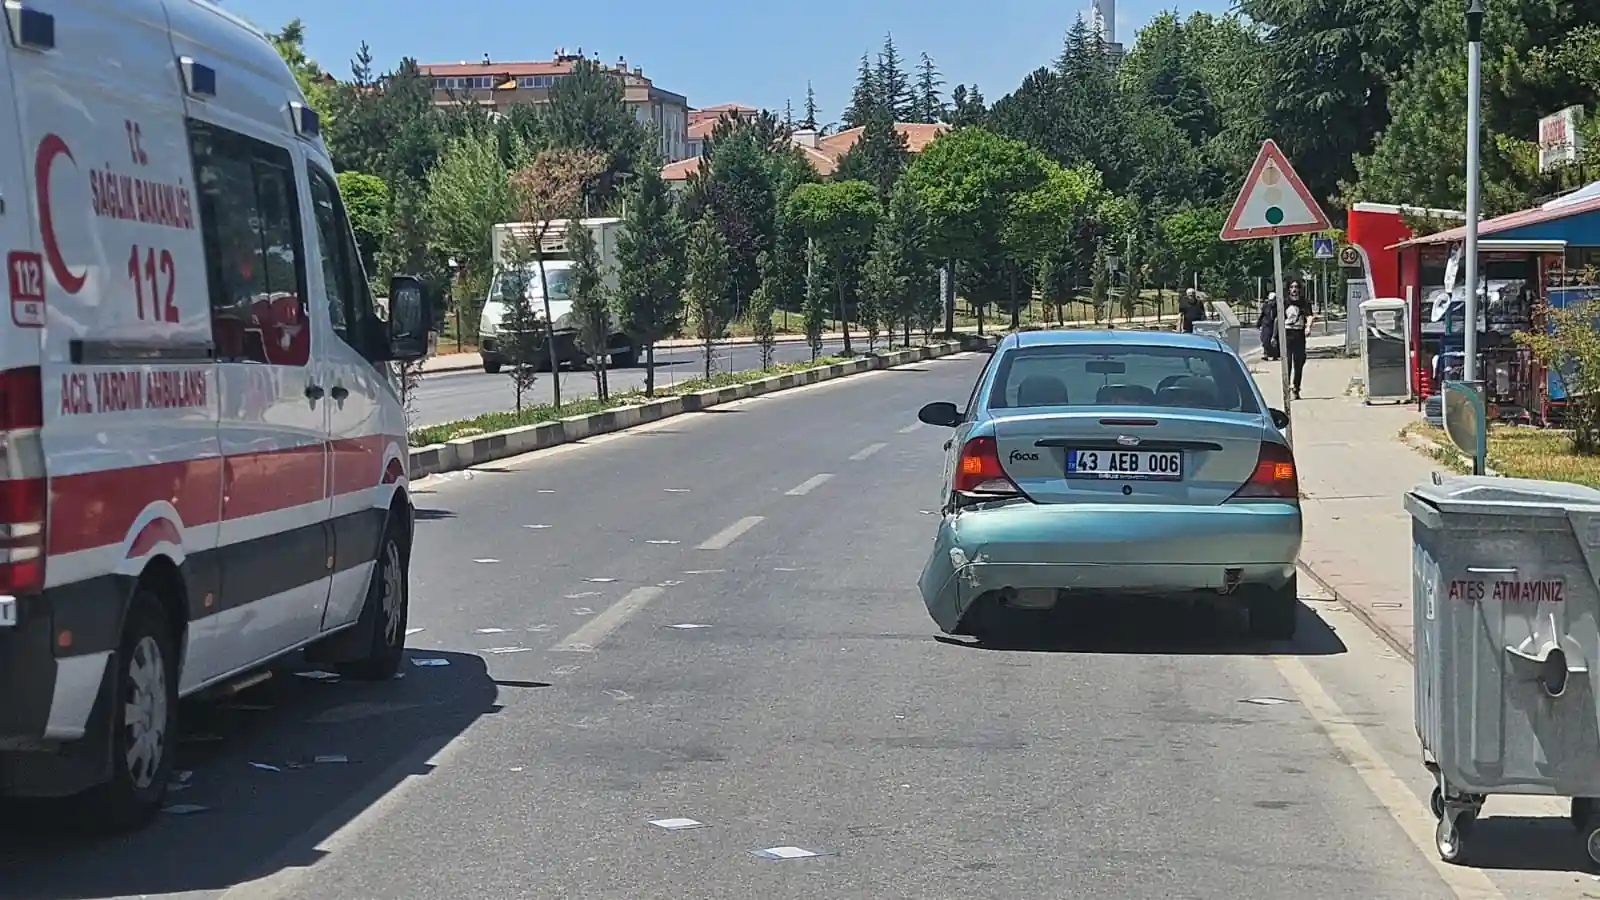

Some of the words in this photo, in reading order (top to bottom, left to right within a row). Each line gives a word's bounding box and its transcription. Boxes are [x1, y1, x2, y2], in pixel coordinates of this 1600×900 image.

[89, 161, 138, 220] SAĞLIK
[135, 177, 195, 230] BAKANLIĞI
[1344, 251, 1355, 261] 30
[14, 259, 41, 296] 112
[128, 243, 180, 323] 112
[93, 371, 143, 413] YARDIM
[145, 370, 207, 409] AMBULANSI
[1078, 452, 1098, 471] 43
[1108, 453, 1139, 472] AEB
[1148, 454, 1179, 473] 006
[1492, 580, 1563, 602] ATMAYINIZ
